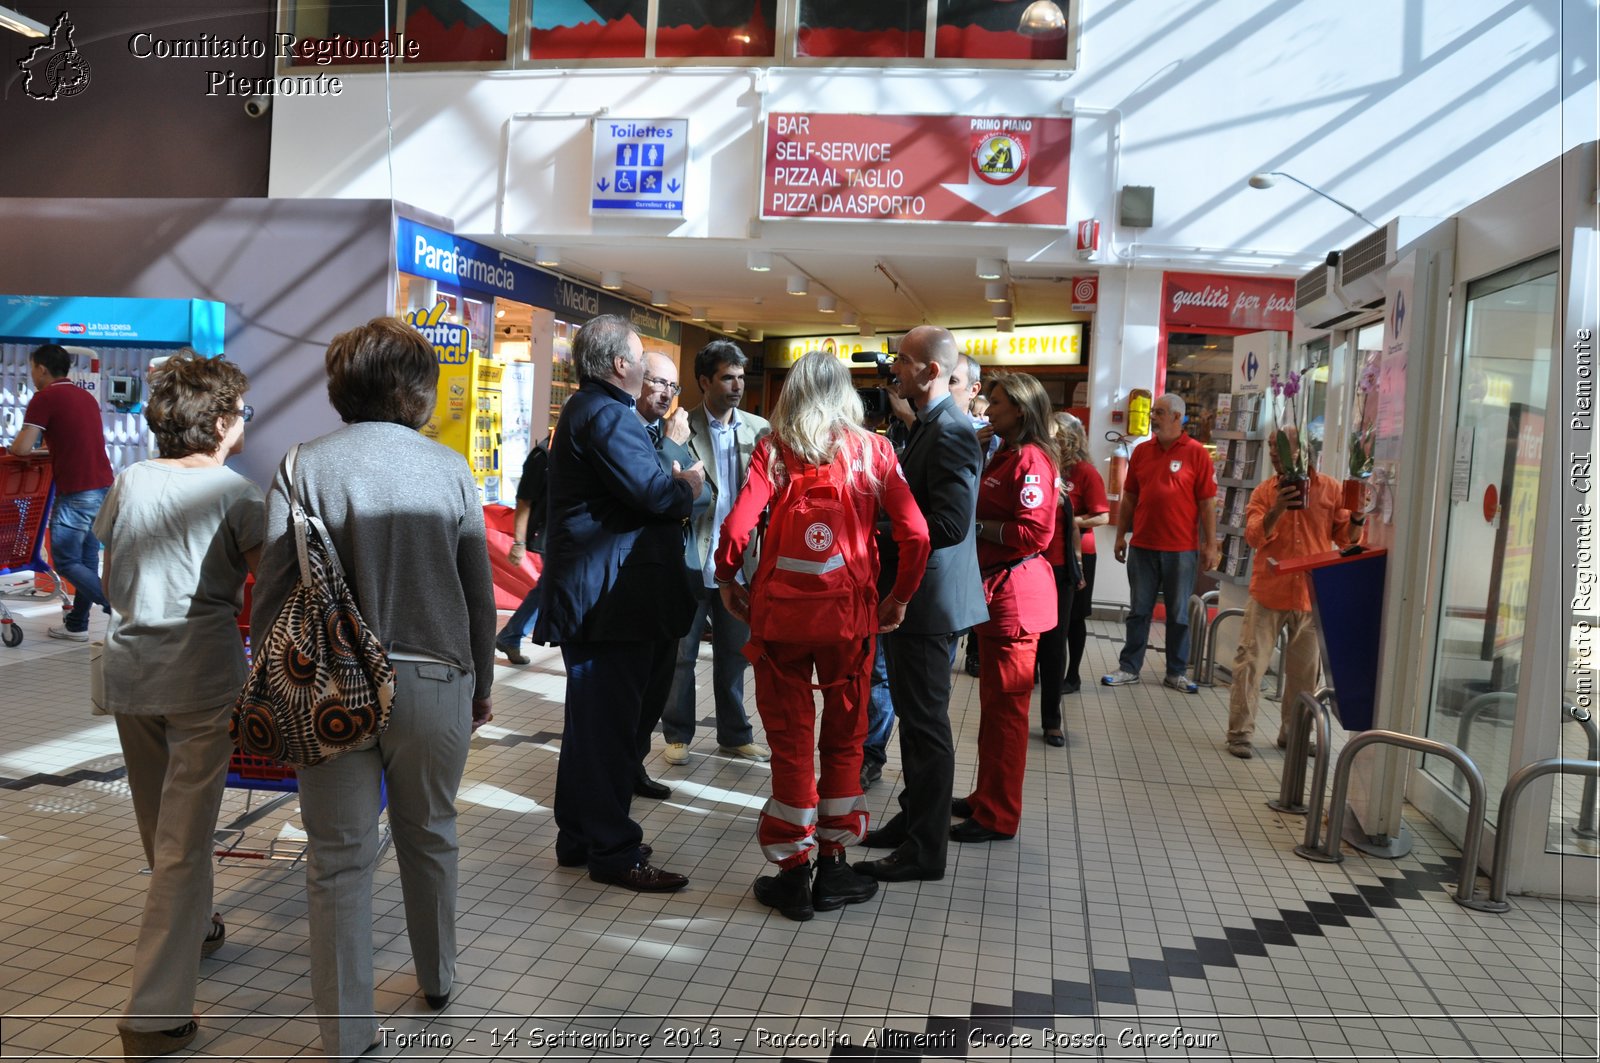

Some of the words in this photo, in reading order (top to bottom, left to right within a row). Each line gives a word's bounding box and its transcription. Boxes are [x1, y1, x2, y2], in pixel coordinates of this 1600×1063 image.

[610, 123, 673, 138] Toilettes
[777, 116, 810, 135] BAR
[970, 119, 1000, 130] PRIMO
[1003, 119, 1032, 132] PIANO
[775, 141, 892, 162] SELF-SERVICE
[774, 167, 819, 187] PIZZA
[821, 168, 842, 187] AL
[845, 168, 904, 188] TAGLIO
[773, 193, 818, 212] PIZZA
[821, 194, 844, 213] DA
[845, 194, 926, 215] ASPORTO
[415, 235, 514, 291] Parafarmacia
[563, 282, 599, 315] Medical
[1172, 285, 1230, 313] qualità
[1232, 292, 1260, 315] per
[1263, 293, 1297, 316] pas
[965, 338, 999, 356] SELF
[1008, 335, 1079, 355] SERVICE
